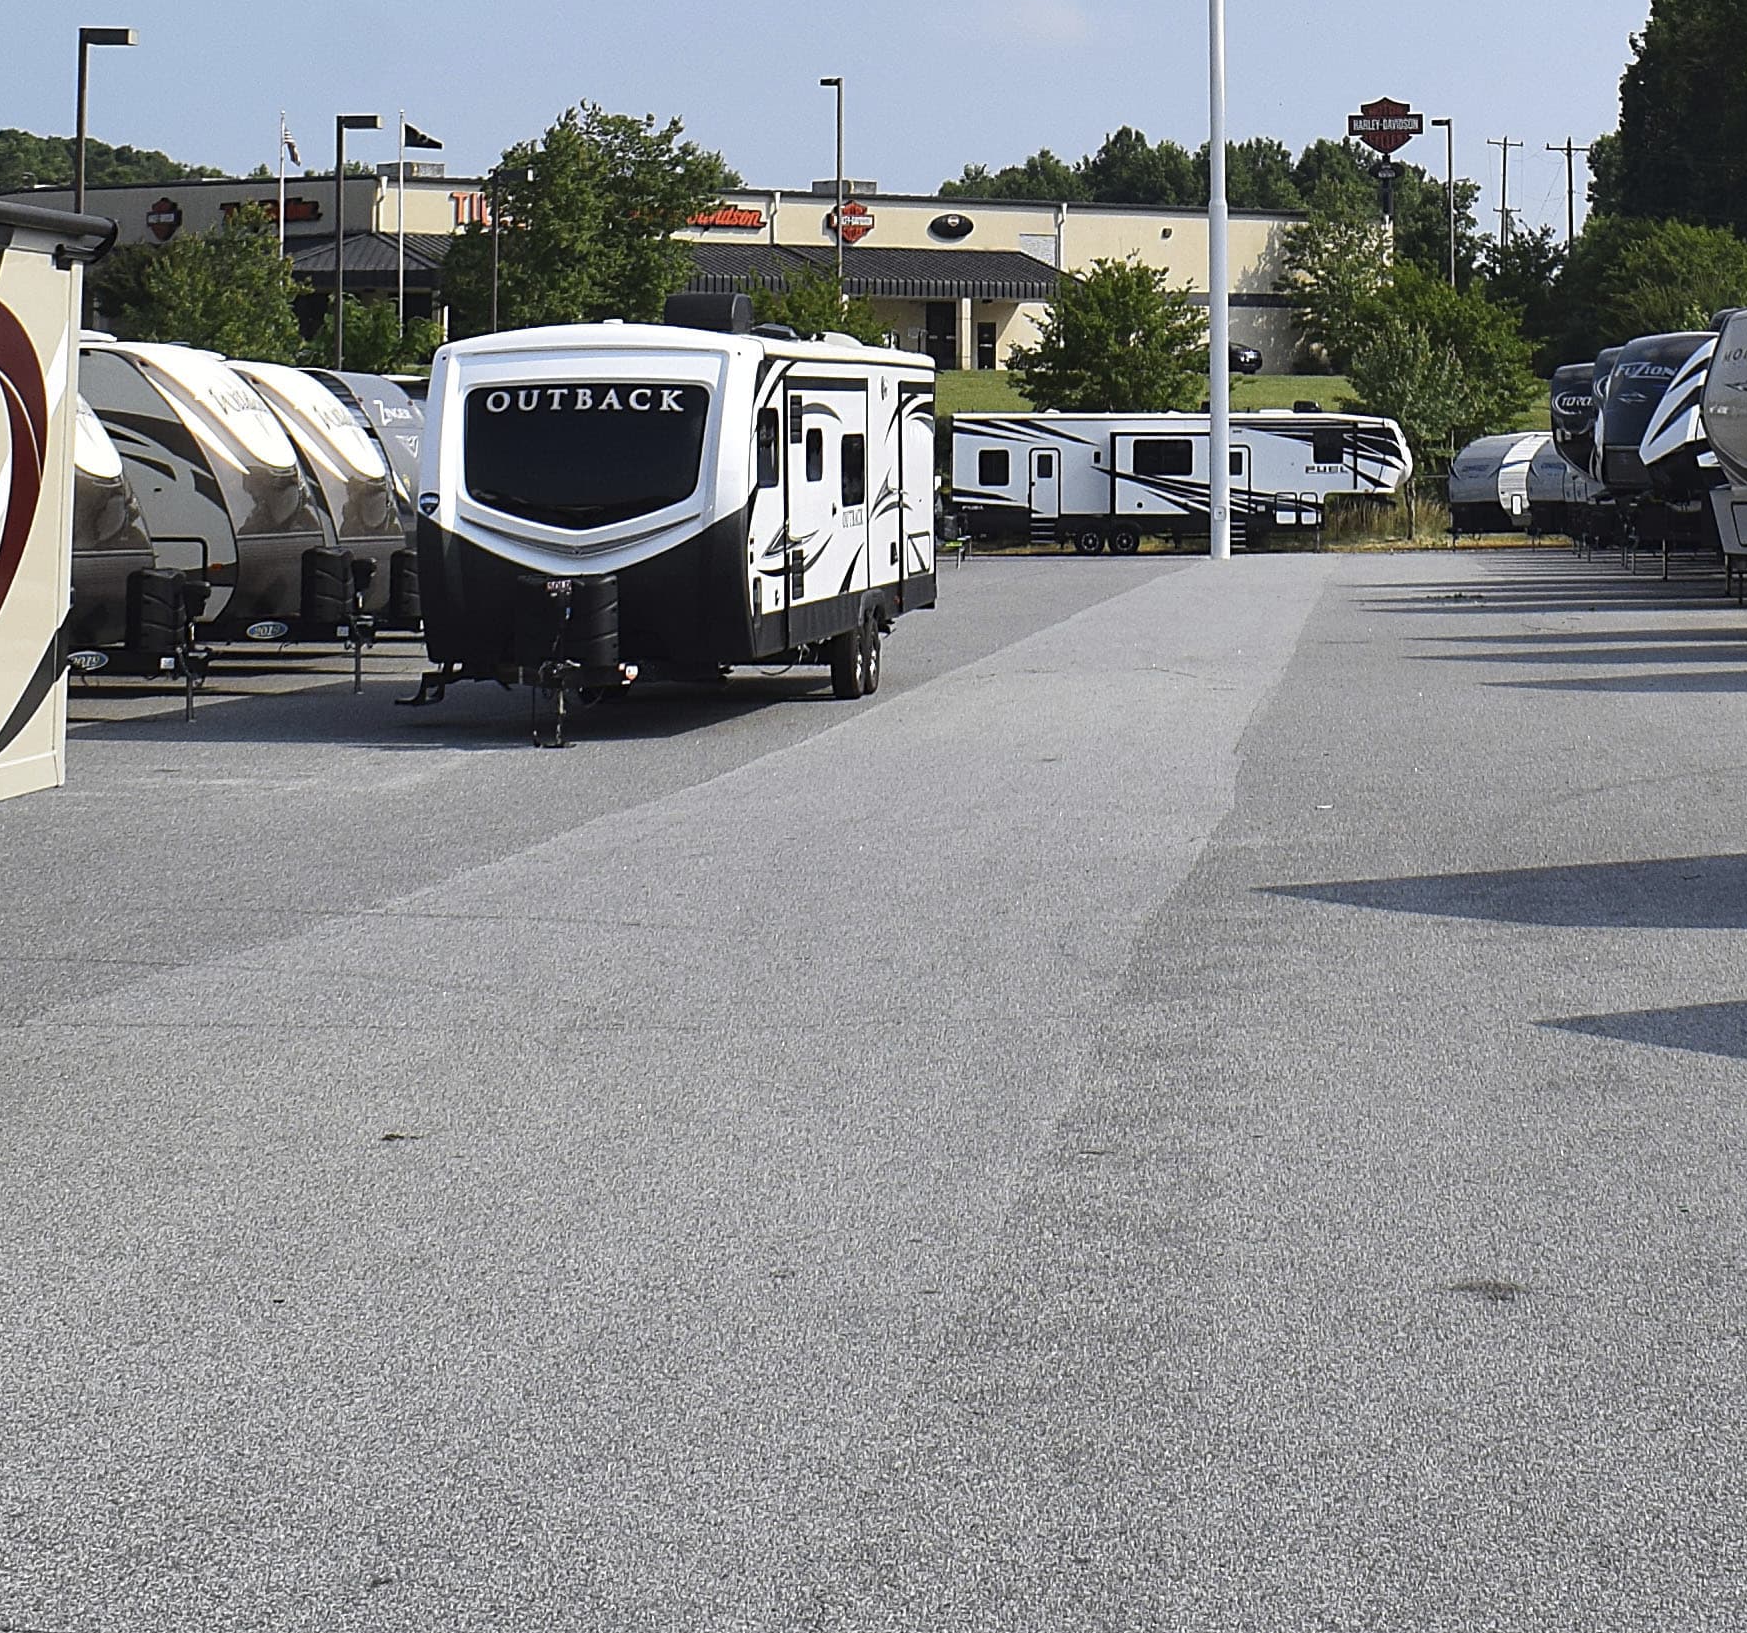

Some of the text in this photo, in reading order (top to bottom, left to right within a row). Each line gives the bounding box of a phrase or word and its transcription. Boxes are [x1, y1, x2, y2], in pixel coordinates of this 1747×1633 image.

[1353, 118, 1418, 131] HARLEY-DAVIDSON
[485, 388, 685, 413] OUTBACK
[1305, 464, 1349, 474] FUEL
